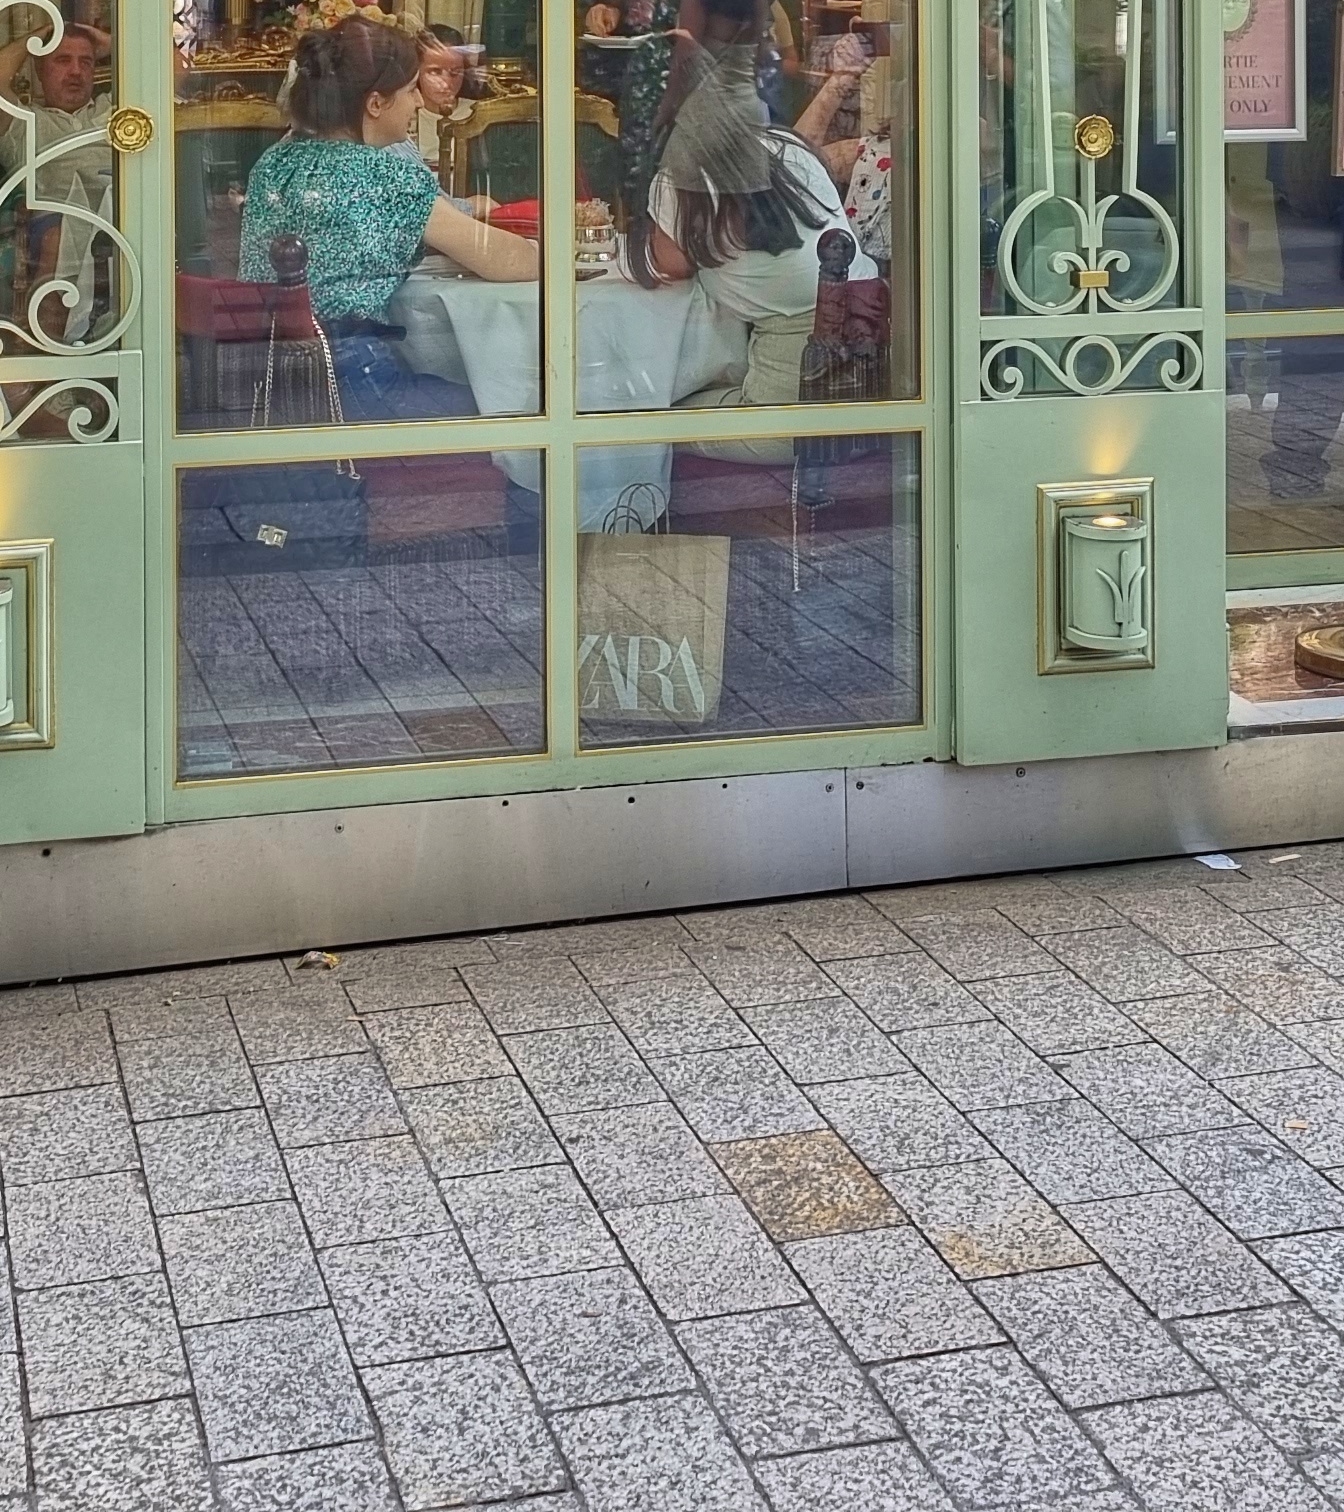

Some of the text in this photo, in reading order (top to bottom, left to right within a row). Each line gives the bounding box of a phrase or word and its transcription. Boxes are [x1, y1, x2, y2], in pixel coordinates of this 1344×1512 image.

[1224, 55, 1258, 69] RTIE
[1229, 99, 1271, 114] ONLY
[577, 633, 705, 714] ZARA
